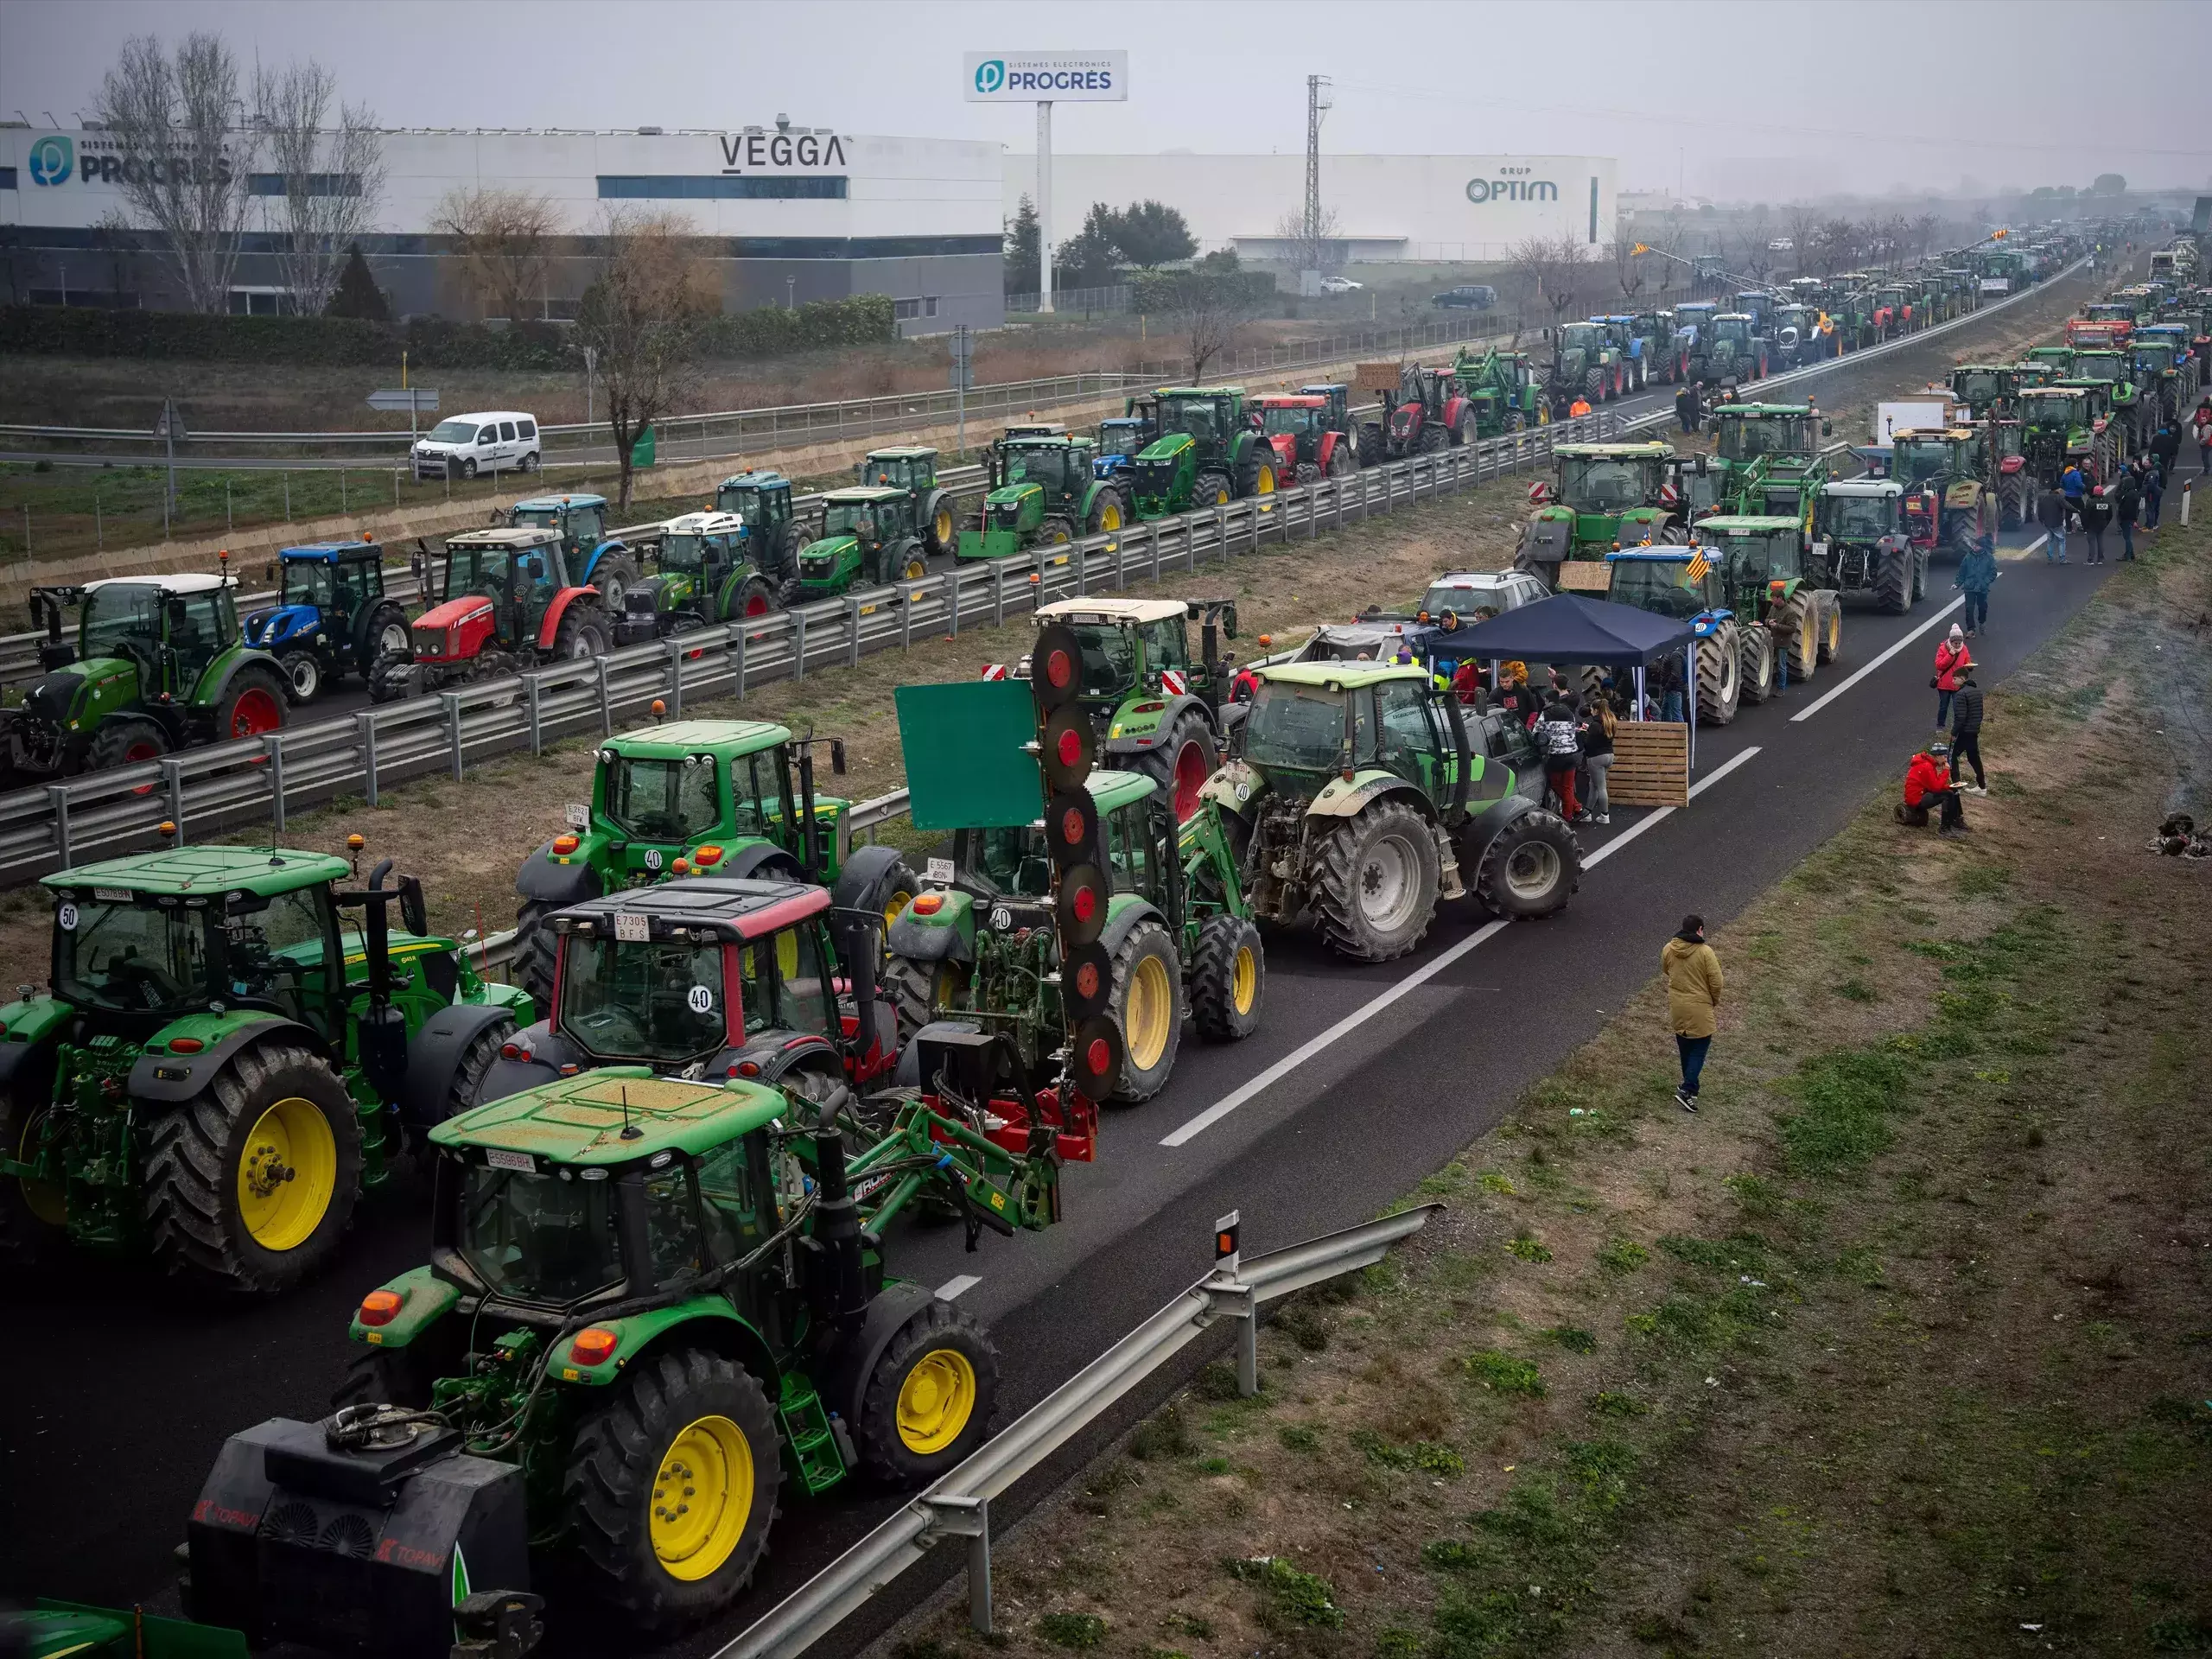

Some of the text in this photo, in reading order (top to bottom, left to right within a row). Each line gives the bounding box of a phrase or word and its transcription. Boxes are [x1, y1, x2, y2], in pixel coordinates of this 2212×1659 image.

[720, 136, 846, 174] VEGGA
[1500, 167, 1532, 175] GRUP
[1237, 785, 1248, 800] 40
[646, 850, 660, 868] 40
[937, 861, 952, 870] 5567
[63, 907, 75, 926] 50
[616, 915, 646, 926] E7305
[994, 909, 1008, 928] 40
[691, 989, 709, 1008] 40
